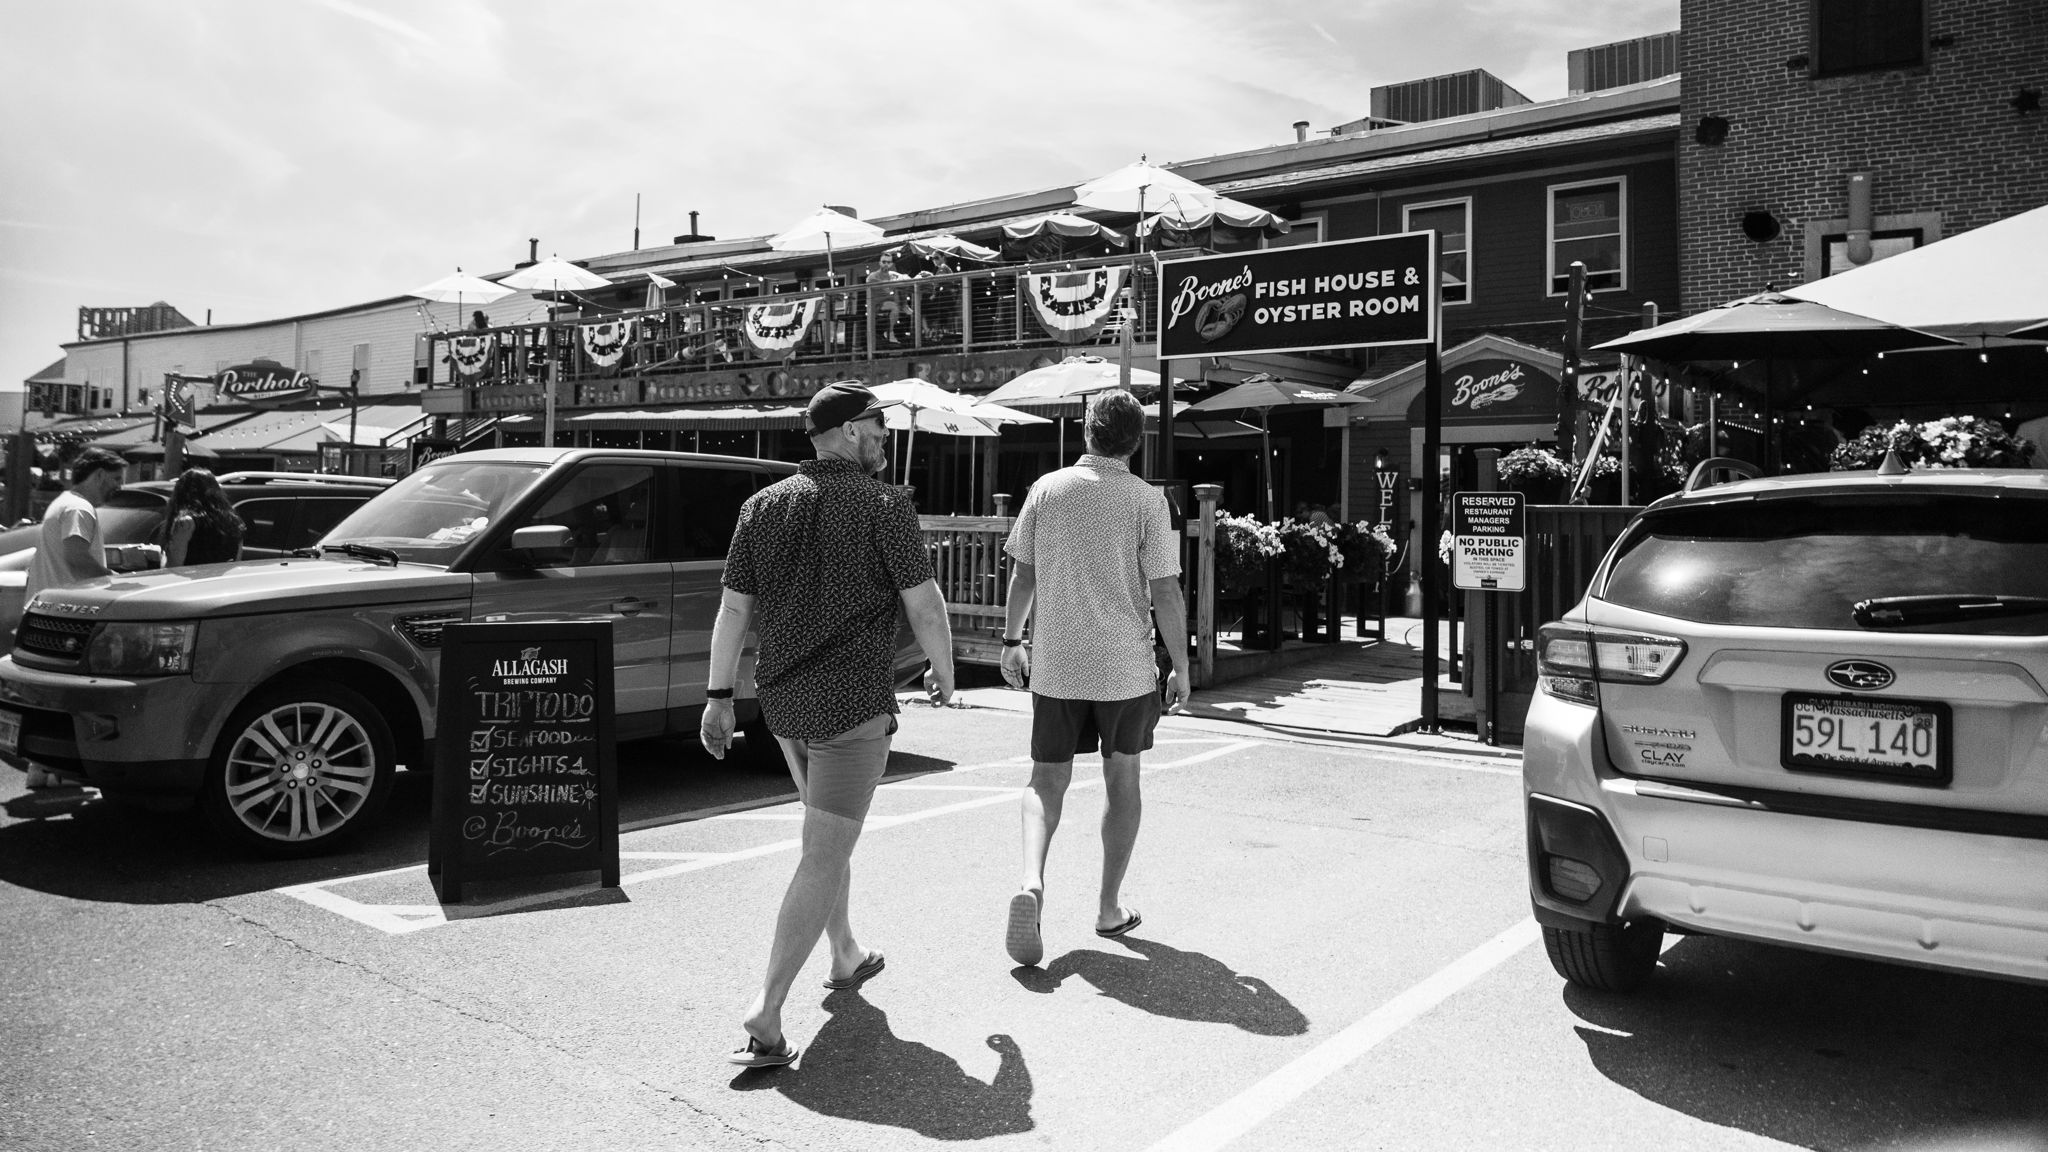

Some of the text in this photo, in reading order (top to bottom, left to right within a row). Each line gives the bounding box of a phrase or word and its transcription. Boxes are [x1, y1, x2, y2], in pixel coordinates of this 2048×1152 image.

[1255, 266, 1420, 299] FISH HOUSE &
[1168, 265, 1253, 330] Boone's
[1254, 295, 1420, 325] OYSTER ROOM
[219, 370, 312, 393] Porthole
[1451, 363, 1525, 406] Boone's
[1462, 497, 1516, 506] RESERVED
[1464, 508, 1513, 516] RESTAURANT
[1468, 517, 1510, 525] MANAGERS
[1472, 525, 1505, 533] PARKING
[1459, 538, 1520, 548] NO PUBLIC
[1464, 547, 1514, 557] PARKING
[57, 603, 100, 614] ROVER
[491, 658, 568, 677] ALLAGASH
[503, 676, 557, 685] BREWING COMPANY
[562, 692, 595, 718] DO
[1795, 714, 1932, 758] 59L 140
[1641, 749, 1685, 763] CLAY
[492, 755, 569, 778] SIGHTS
